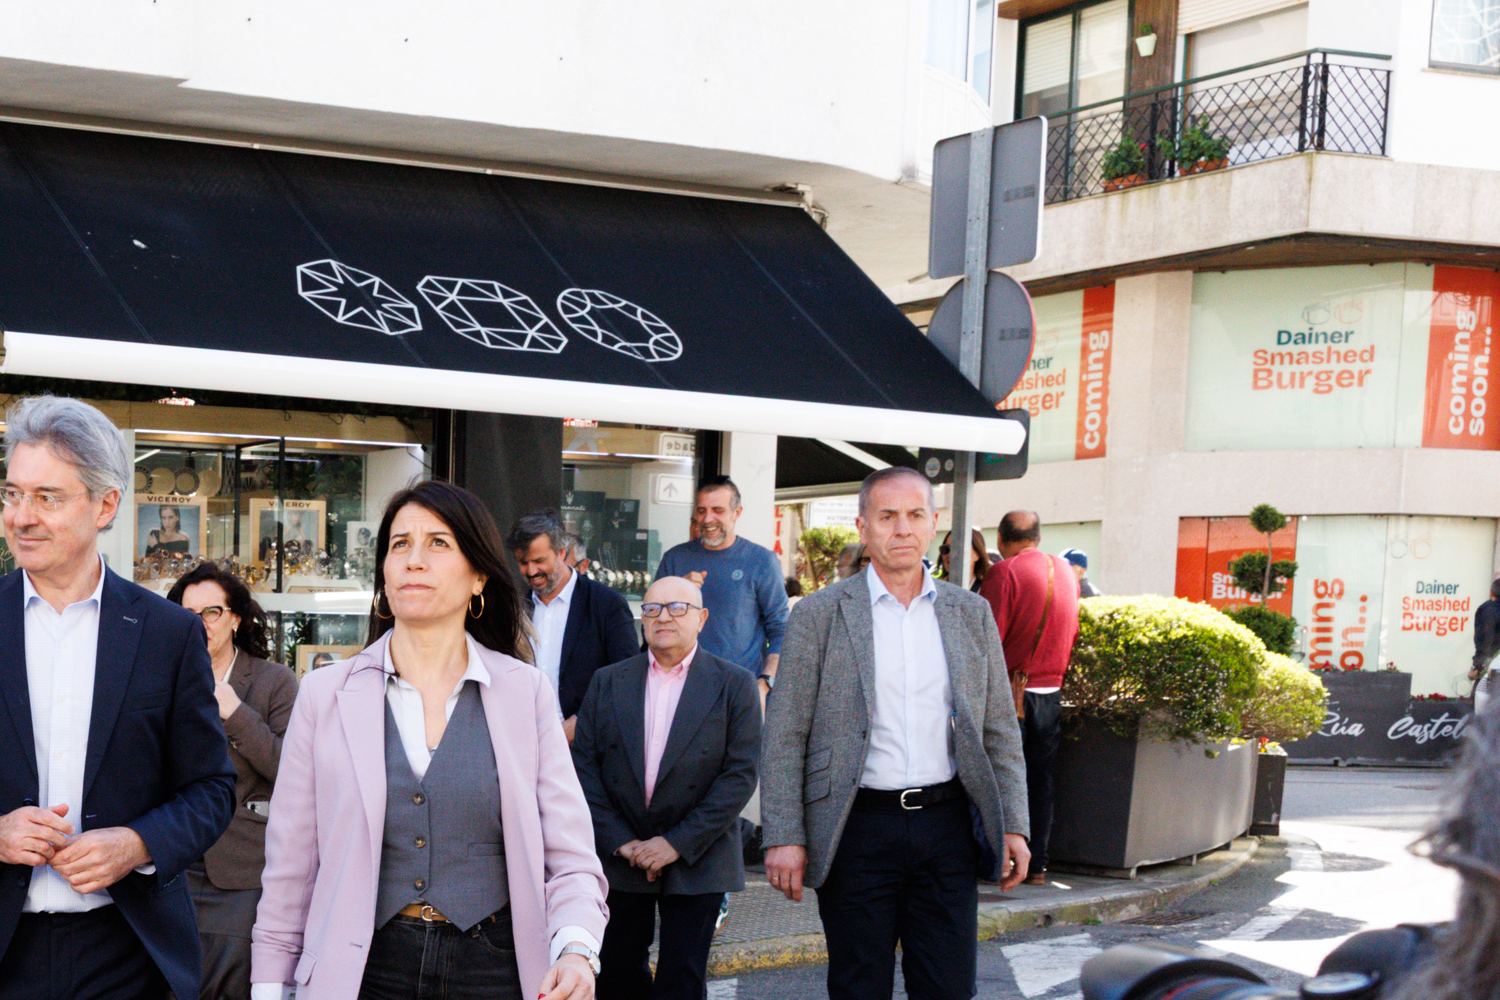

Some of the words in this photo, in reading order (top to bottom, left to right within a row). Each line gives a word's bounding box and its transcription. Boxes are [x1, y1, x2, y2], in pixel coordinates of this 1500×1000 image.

[1276, 327, 1355, 346] Dainer
[1027, 357, 1053, 371] ner
[1252, 344, 1375, 366] Smashed
[1014, 369, 1067, 391] ashed
[1252, 368, 1372, 394] Burger
[1448, 310, 1477, 435] coming
[1469, 326, 1492, 436] soon...
[1084, 330, 1110, 449] coming
[997, 391, 1065, 417] urger
[147, 495, 191, 503] VICEROY
[268, 500, 311, 508] VIEROY
[1416, 580, 1459, 595] Dainer
[1402, 596, 1470, 612] Smashed
[1309, 578, 1345, 671] ming
[1340, 594, 1368, 671] on...
[1401, 612, 1468, 637] Burger
[1387, 712, 1471, 744] Castel
